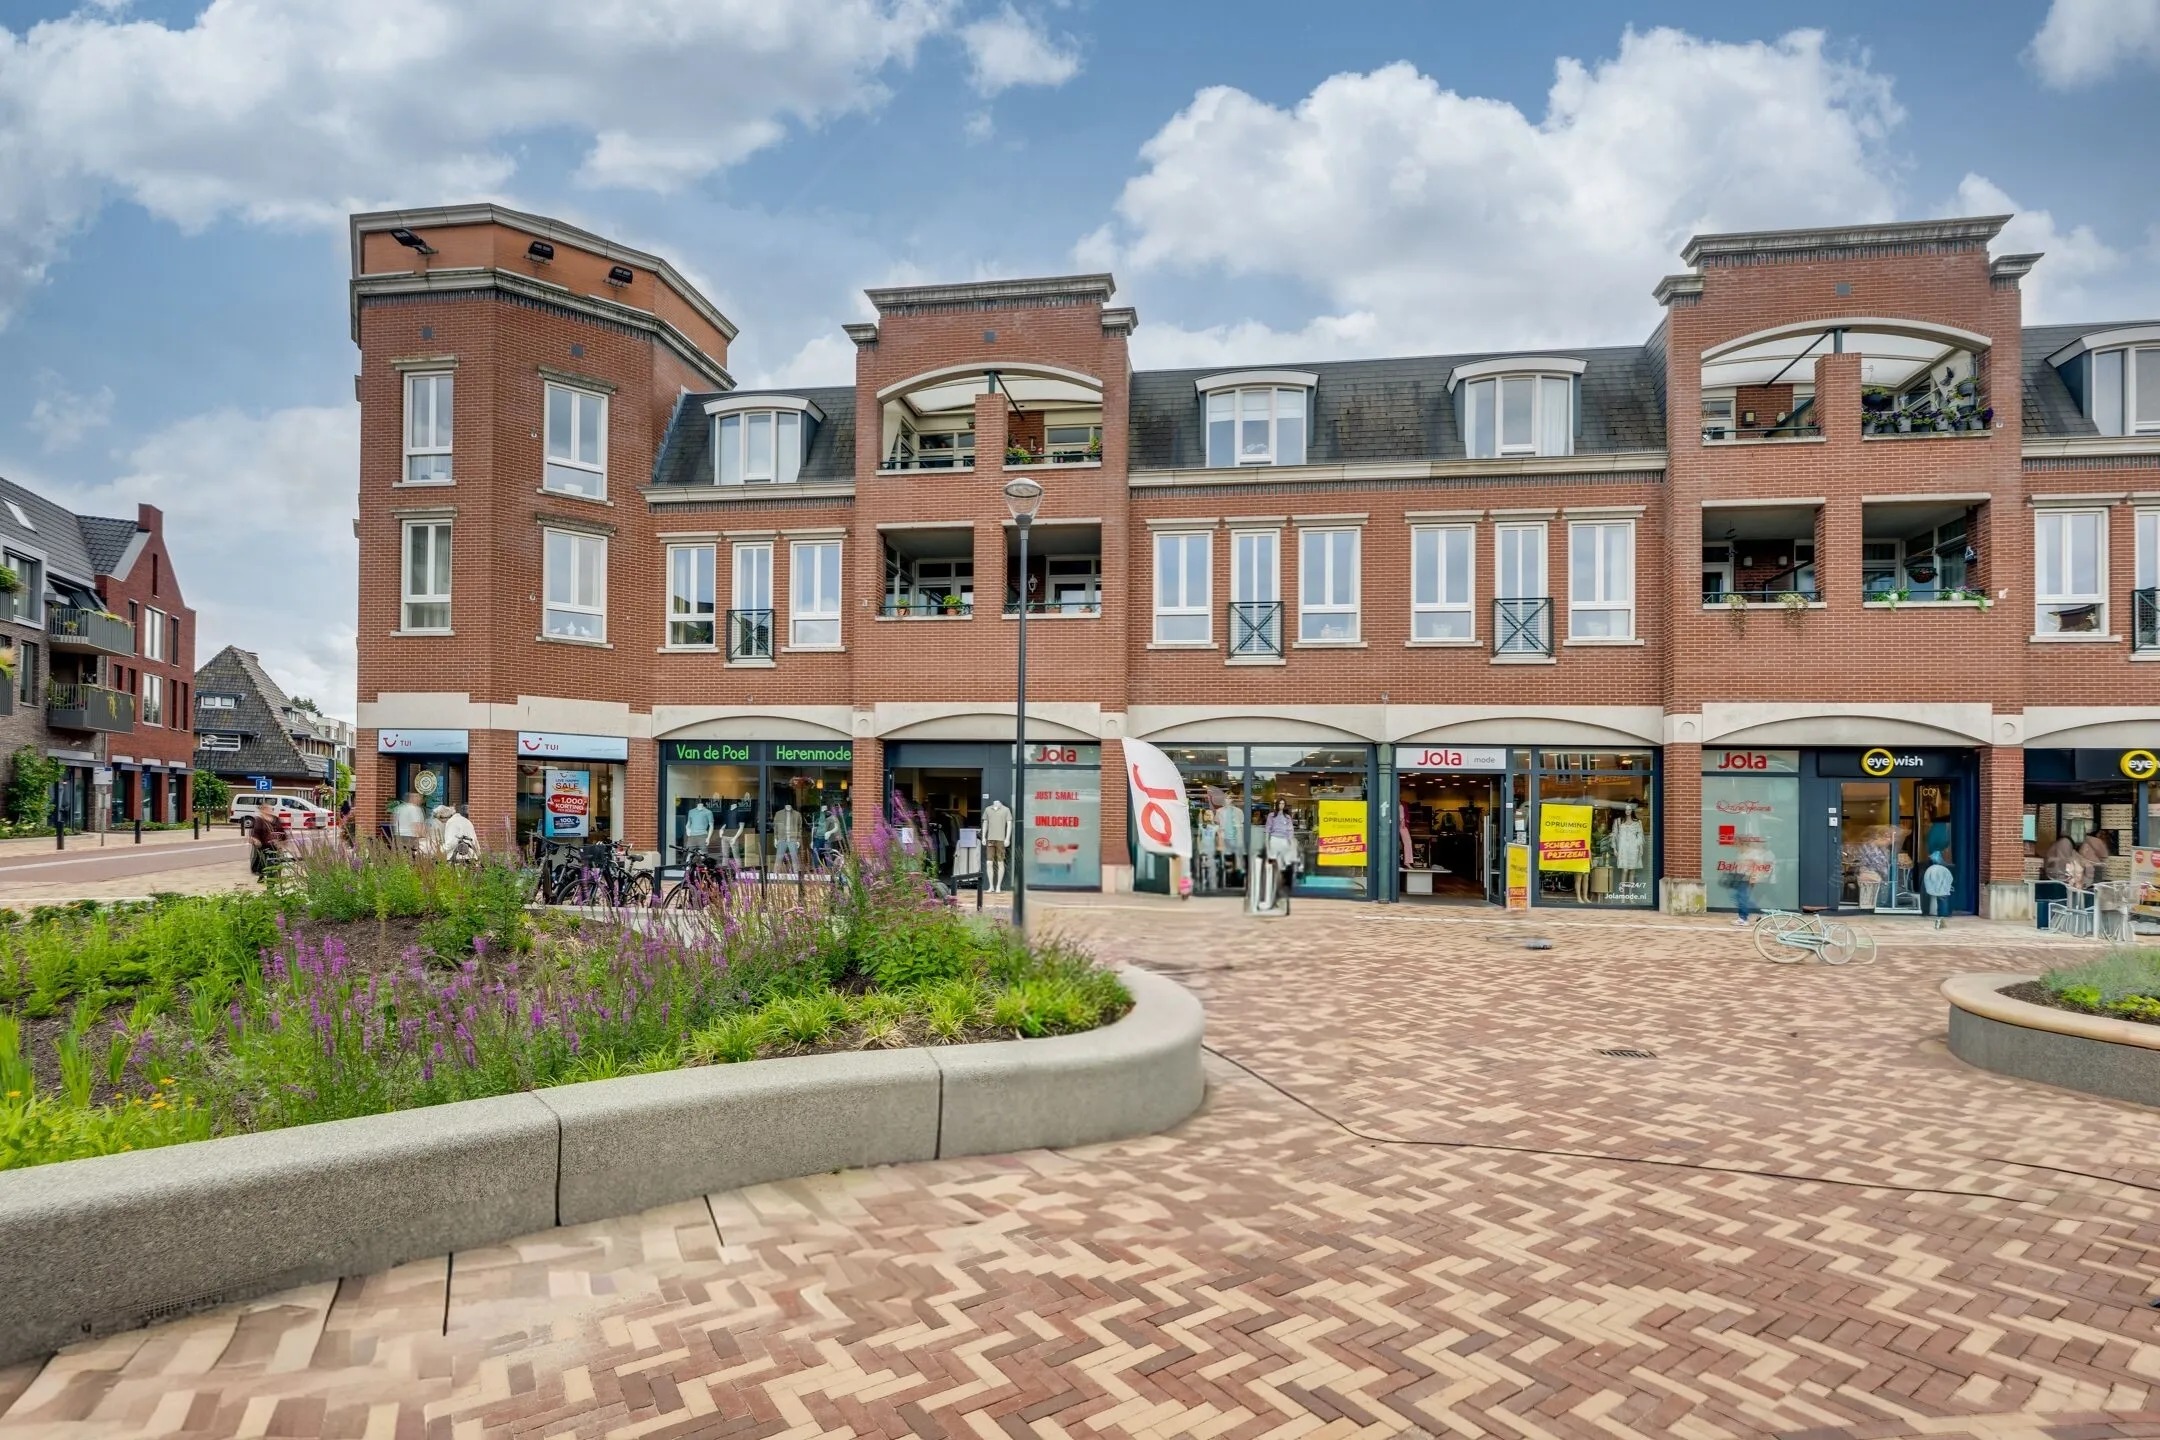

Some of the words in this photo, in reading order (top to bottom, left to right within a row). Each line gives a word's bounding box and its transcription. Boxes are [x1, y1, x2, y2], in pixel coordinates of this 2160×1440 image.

[544, 743, 559, 751] TUI
[676, 744, 701, 760] Van
[703, 745, 720, 760] de
[722, 745, 749, 760] Poel
[776, 745, 851, 761] Herenmode
[1037, 746, 1077, 763] Jola
[1417, 750, 1462, 766] Jola
[1474, 756, 1496, 764] mode
[1719, 752, 1767, 770] Jola
[259, 780, 268, 790] P
[555, 782, 578, 790] SALE
[1034, 791, 1053, 801] JUST
[1055, 791, 1080, 801] SMALL
[555, 803, 584, 811] KORTING
[1034, 815, 1080, 828] UNLOCKED
[1544, 820, 1588, 829] OPRUIMING
[1543, 841, 1581, 850] SCHERPE
[1630, 881, 1647, 889] 24/7
[1604, 892, 1647, 900] Jolamode.nl
